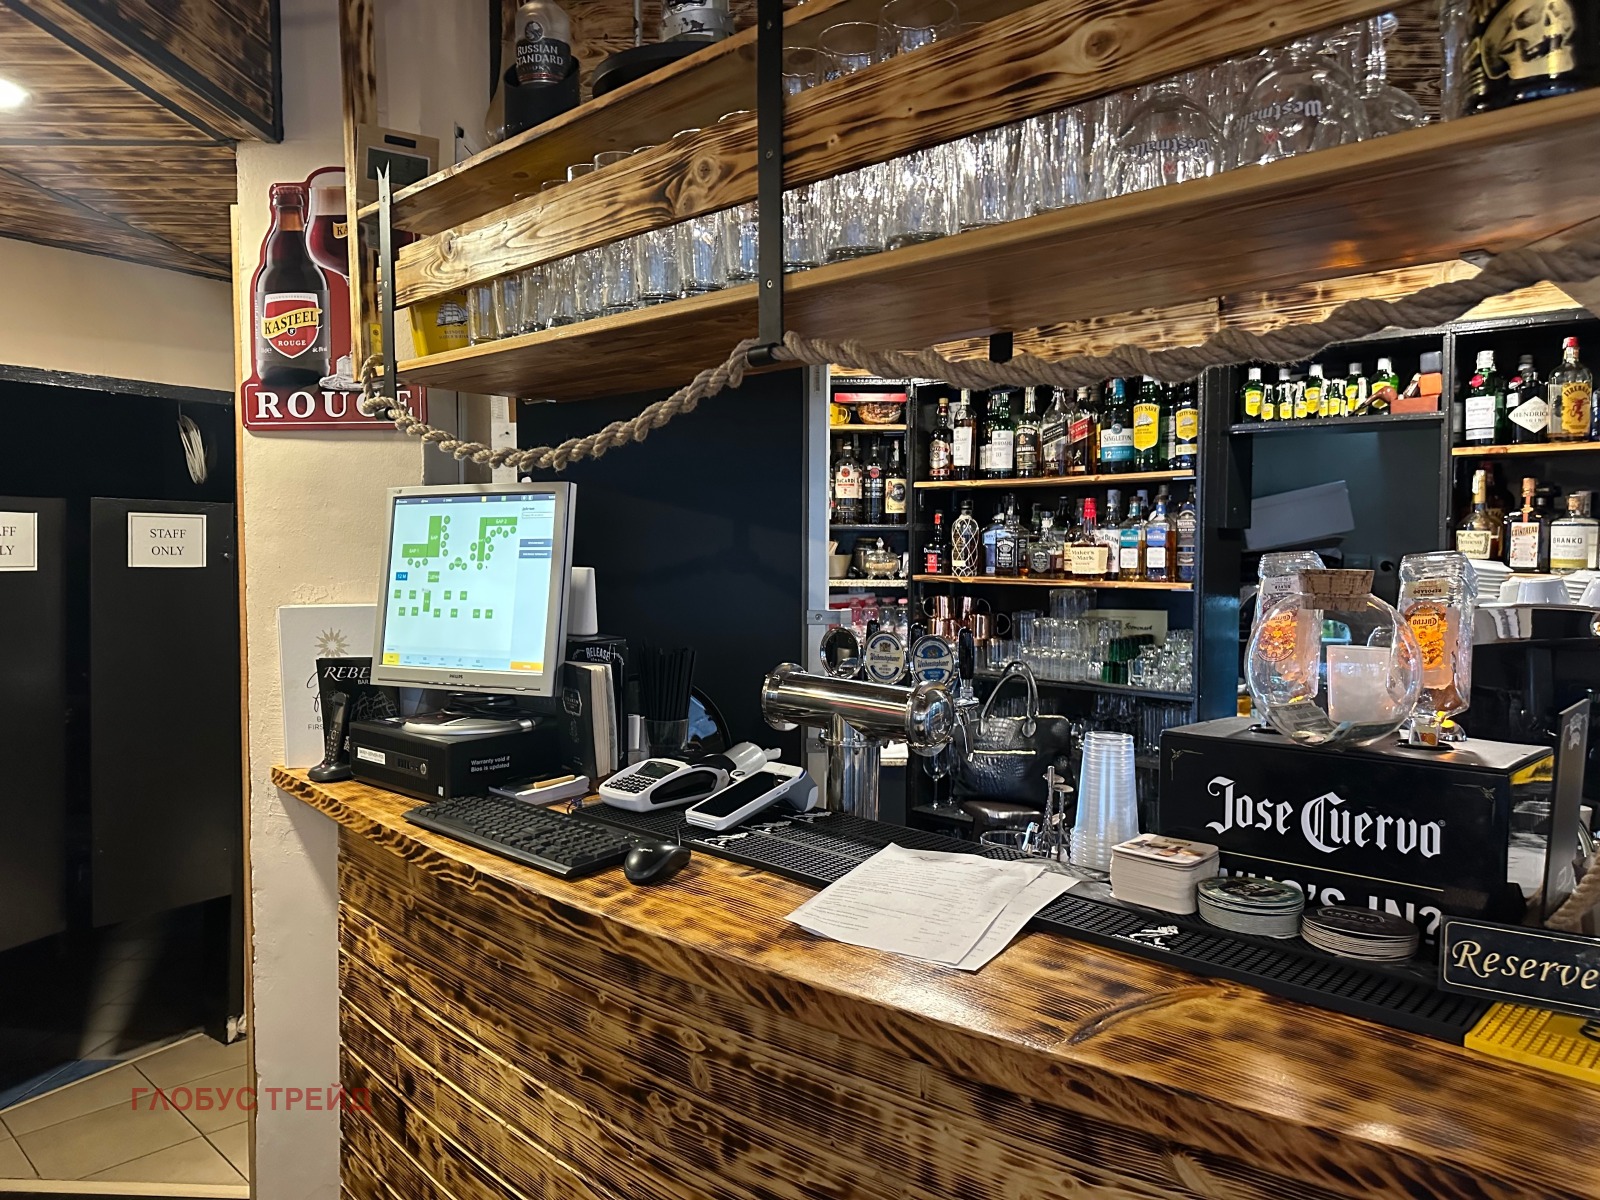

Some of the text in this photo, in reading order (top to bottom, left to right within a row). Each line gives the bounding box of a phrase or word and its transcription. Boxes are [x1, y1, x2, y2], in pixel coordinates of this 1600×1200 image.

[517, 44, 558, 56] RUSSIAN
[515, 53, 564, 68] STANDARD
[1232, 99, 1323, 130] Westmalle
[1128, 138, 1212, 154] Westmalle
[264, 310, 317, 336] KASTEEL
[1103, 434, 1132, 443] SINGLETON
[1104, 450, 1112, 459] 12
[149, 528, 187, 539] STAFF
[151, 545, 185, 557] ONLY
[323, 666, 371, 682] REBE
[470, 755, 511, 767] Warranty void if
[489, 762, 510, 772] updated
[1205, 776, 1442, 859] Jose Cuervo
[1451, 940, 1600, 990] Reserve
